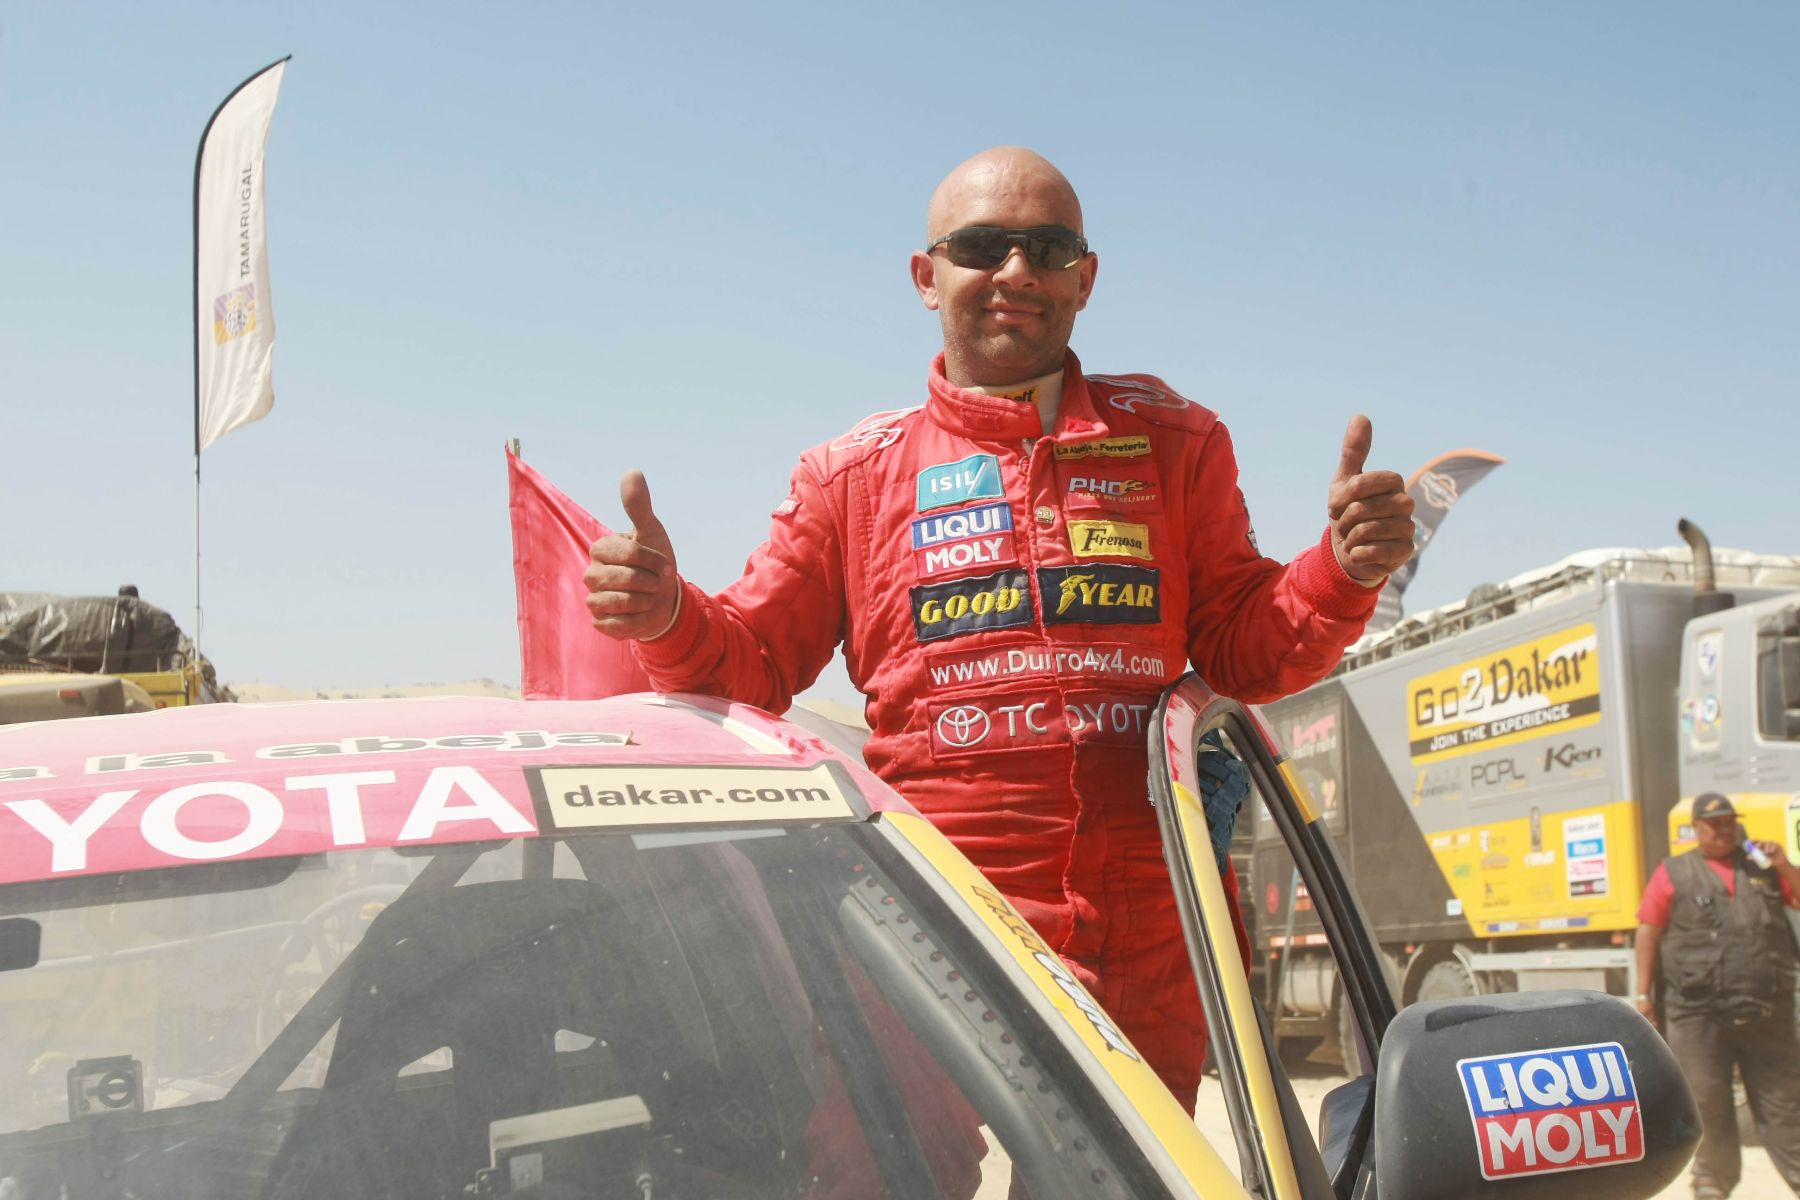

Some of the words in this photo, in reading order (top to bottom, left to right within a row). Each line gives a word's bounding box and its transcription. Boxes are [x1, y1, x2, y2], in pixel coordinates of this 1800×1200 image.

[239, 160, 252, 280] TAMARUGAL
[1099, 441, 1148, 452] Ferreteria
[930, 470, 973, 494] ISIL
[921, 508, 1001, 545] LIQUI
[1081, 527, 1143, 552] Frenosa
[925, 537, 1004, 573] MOLY
[920, 586, 1022, 624] GOOD
[1079, 582, 1154, 608] YEAR
[1430, 734, 1458, 751] JOIN
[1461, 724, 1487, 742] THE
[1490, 704, 1571, 737] EXPERIENCE
[84, 750, 234, 774] la
[255, 730, 629, 760] abeja
[563, 783, 831, 808] dakar.com
[4, 765, 537, 873] YOTA
[1470, 1050, 1627, 1112] LIQUI
[1485, 1106, 1634, 1171] MOLY
